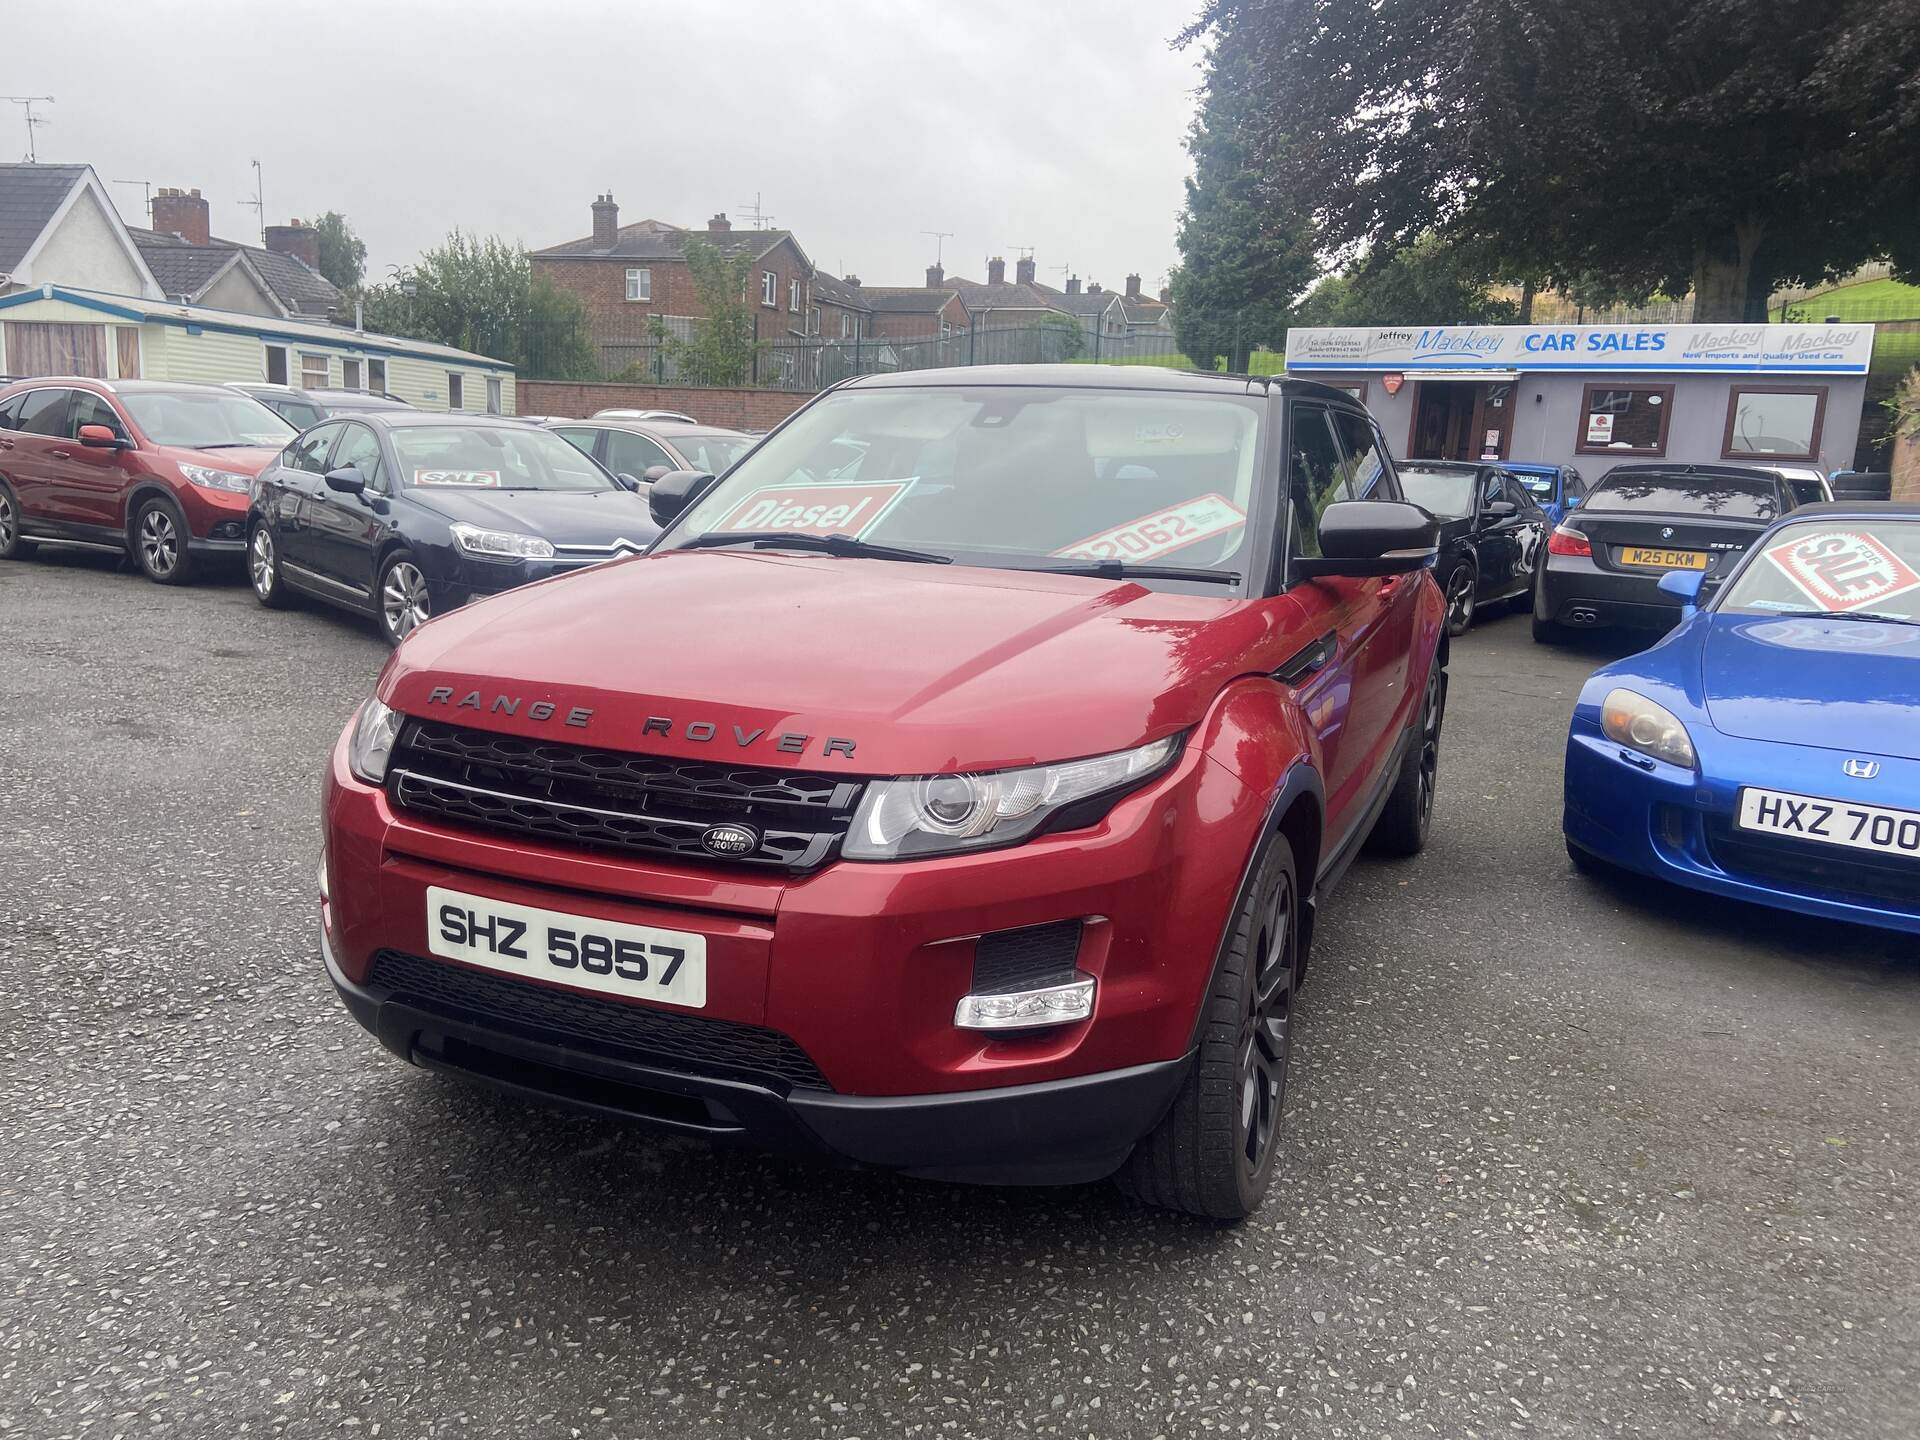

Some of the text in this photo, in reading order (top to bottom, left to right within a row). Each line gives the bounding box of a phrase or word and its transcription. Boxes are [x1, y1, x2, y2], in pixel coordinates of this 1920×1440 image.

[1378, 331, 1413, 342] Jeffrey
[1414, 329, 1505, 354] Mackey
[1524, 333, 1577, 352] CAR
[1587, 332, 1666, 352] SALES
[1687, 329, 1762, 351] Mackey
[1780, 329, 1860, 352] Mackey
[1705, 352, 1739, 360] Imports
[1762, 352, 1794, 361] Quality
[1798, 352, 1820, 360] Used
[1823, 352, 1844, 360] Cars
[423, 472, 489, 484] SALE
[730, 496, 873, 530] Diesel
[1632, 549, 1696, 568] M25 CKM
[1855, 544, 1883, 566] FOR
[1796, 538, 1890, 597] SALE
[427, 686, 857, 758] RANGE ROVER
[1757, 796, 1920, 850] HXZ 700
[439, 904, 685, 986] SHZ 5857
